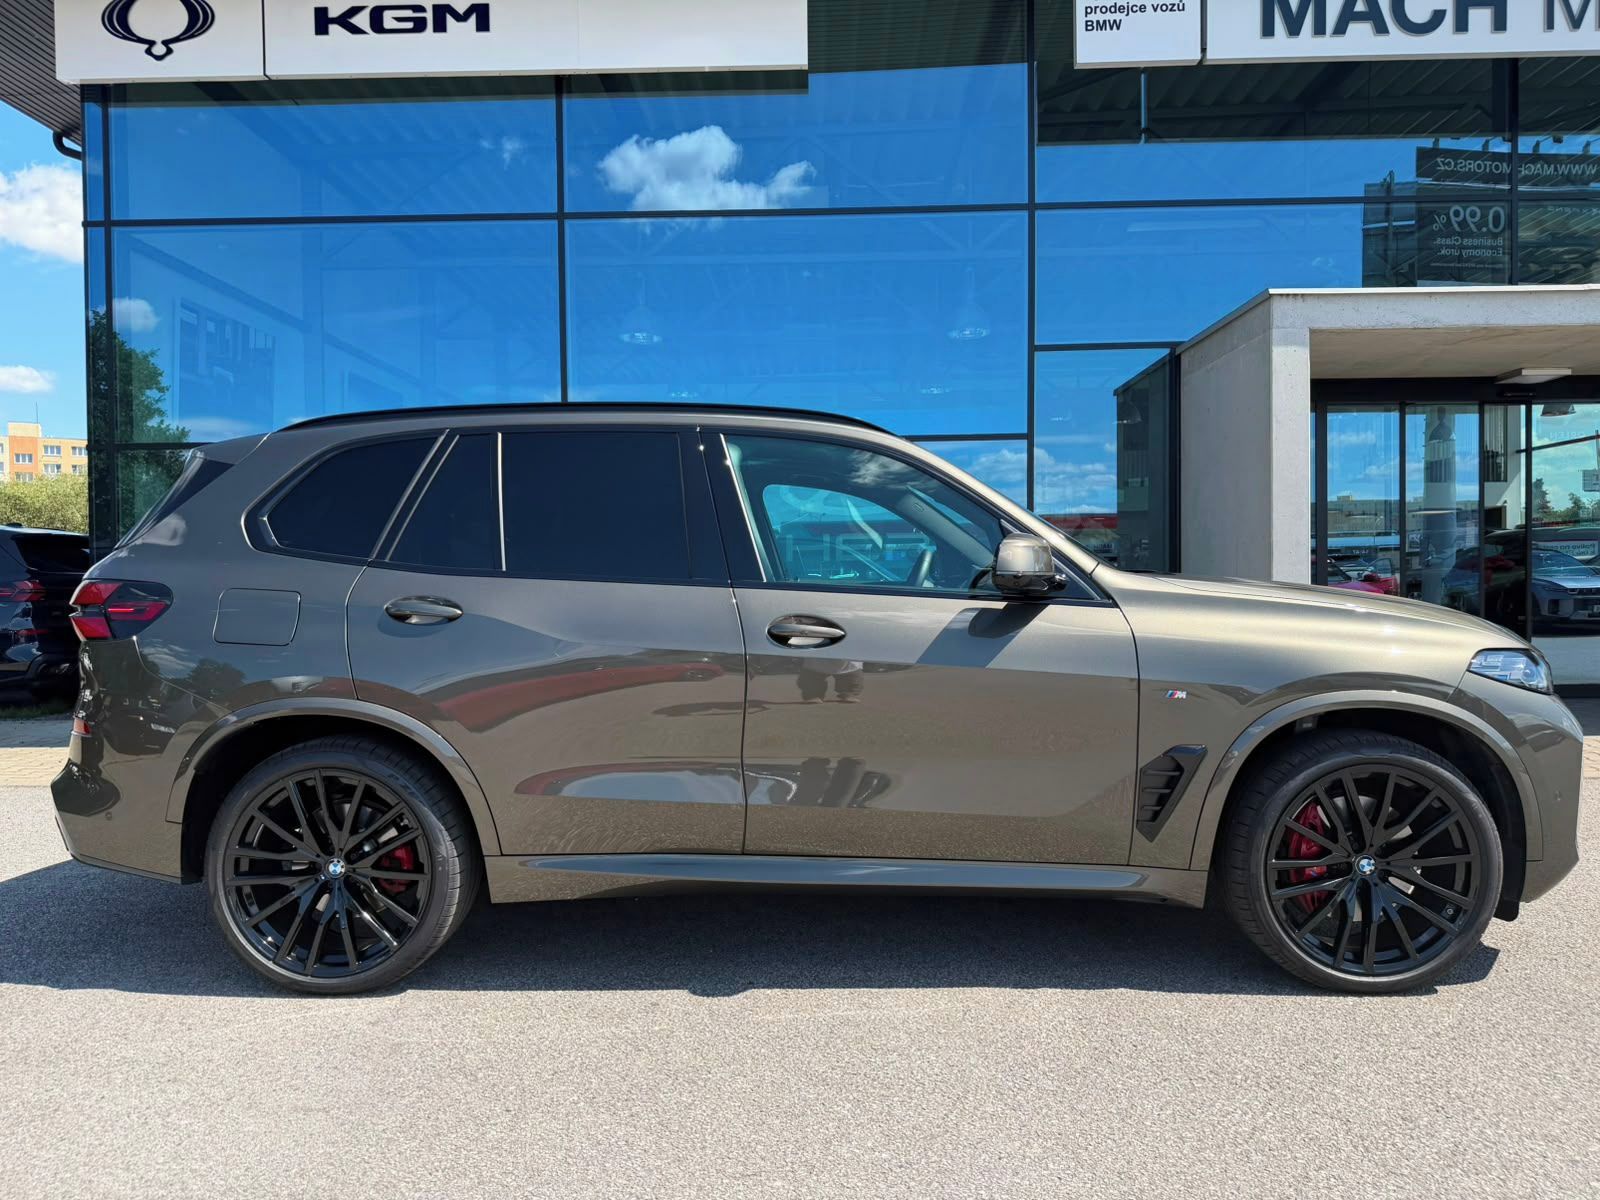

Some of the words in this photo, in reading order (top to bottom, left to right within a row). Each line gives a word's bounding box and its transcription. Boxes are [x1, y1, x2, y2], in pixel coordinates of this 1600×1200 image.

[314, 3, 490, 36] KGM
[1084, 2, 1147, 17] prodejce
[1151, 0, 1186, 13] vozů
[1260, 0, 1508, 38] MACH
[1084, 18, 1122, 32] BMW
